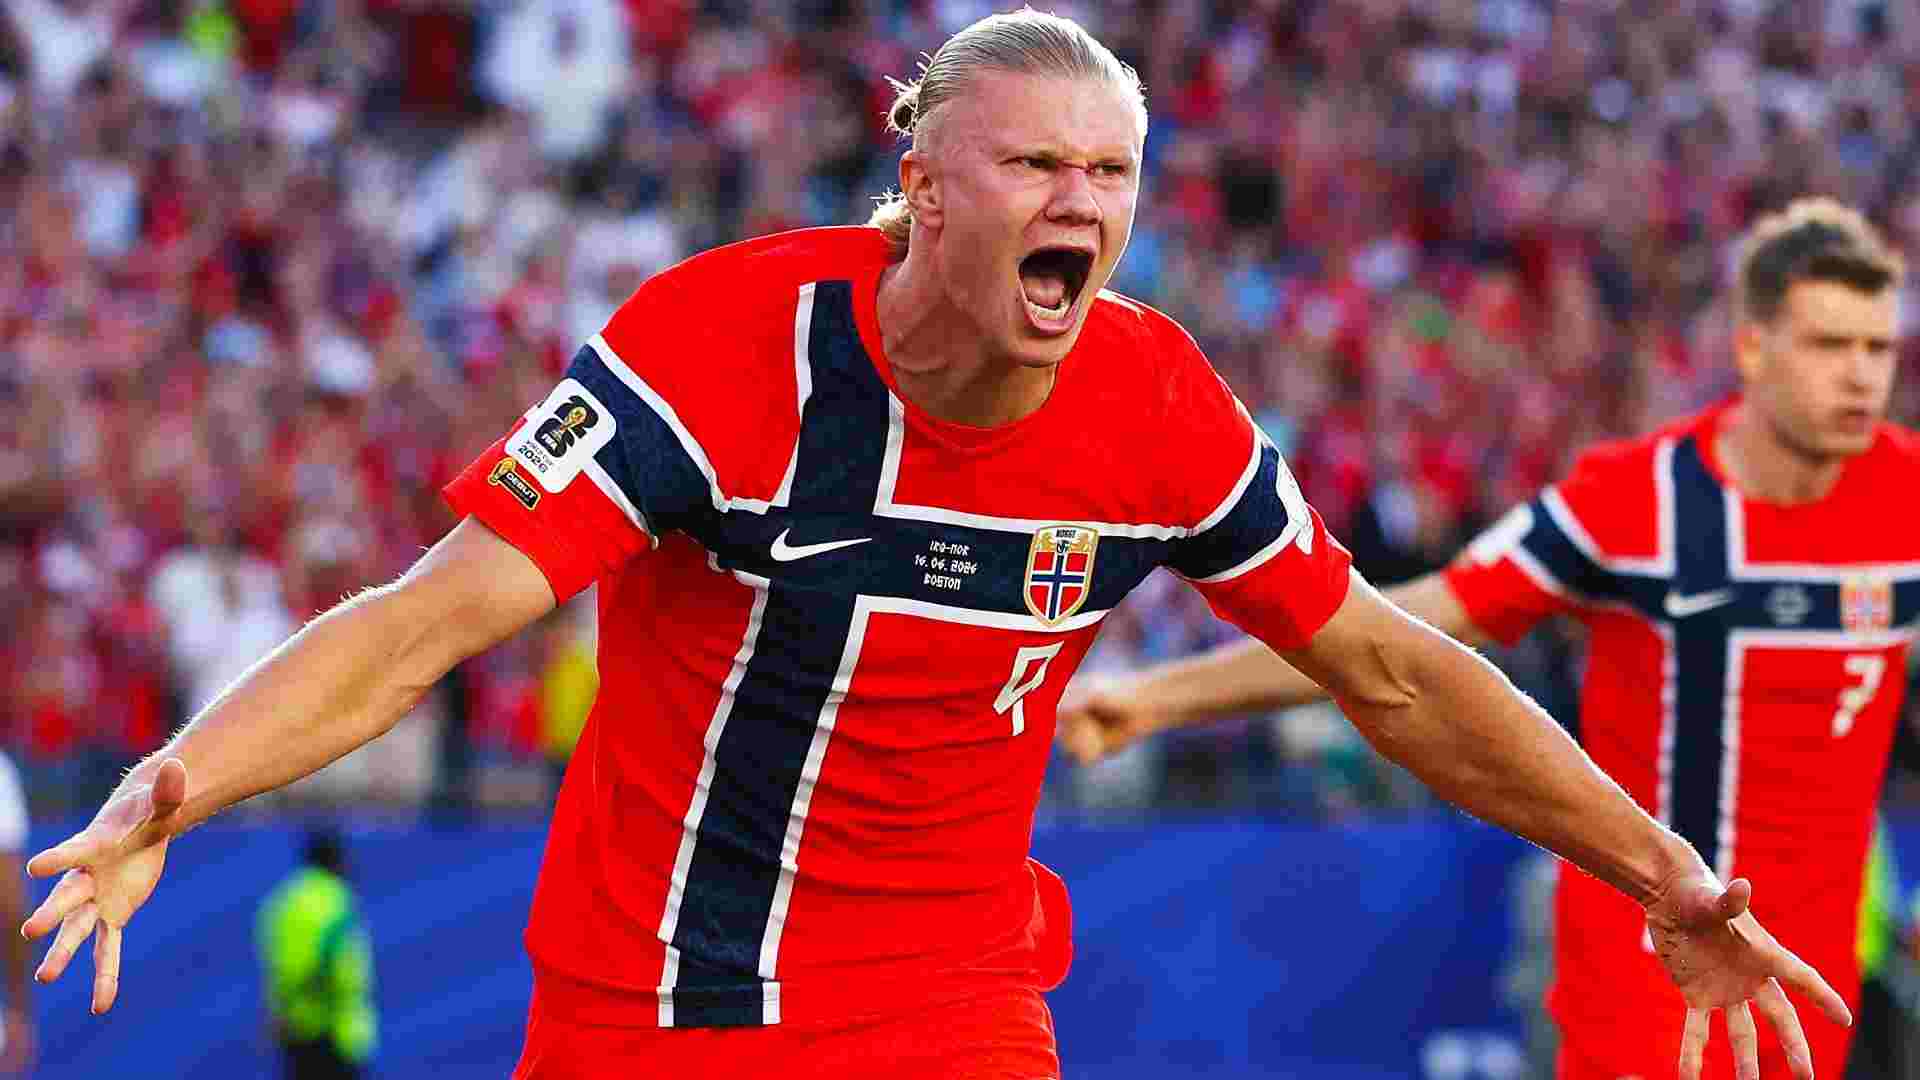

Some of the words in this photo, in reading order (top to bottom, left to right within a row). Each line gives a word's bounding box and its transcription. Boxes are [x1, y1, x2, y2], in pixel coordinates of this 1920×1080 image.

[518, 445, 550, 474] 2026
[505, 473, 537, 500] DEBUT
[923, 572, 961, 590] BOSTON
[993, 640, 1064, 736] 9
[1831, 655, 1887, 738] 7
